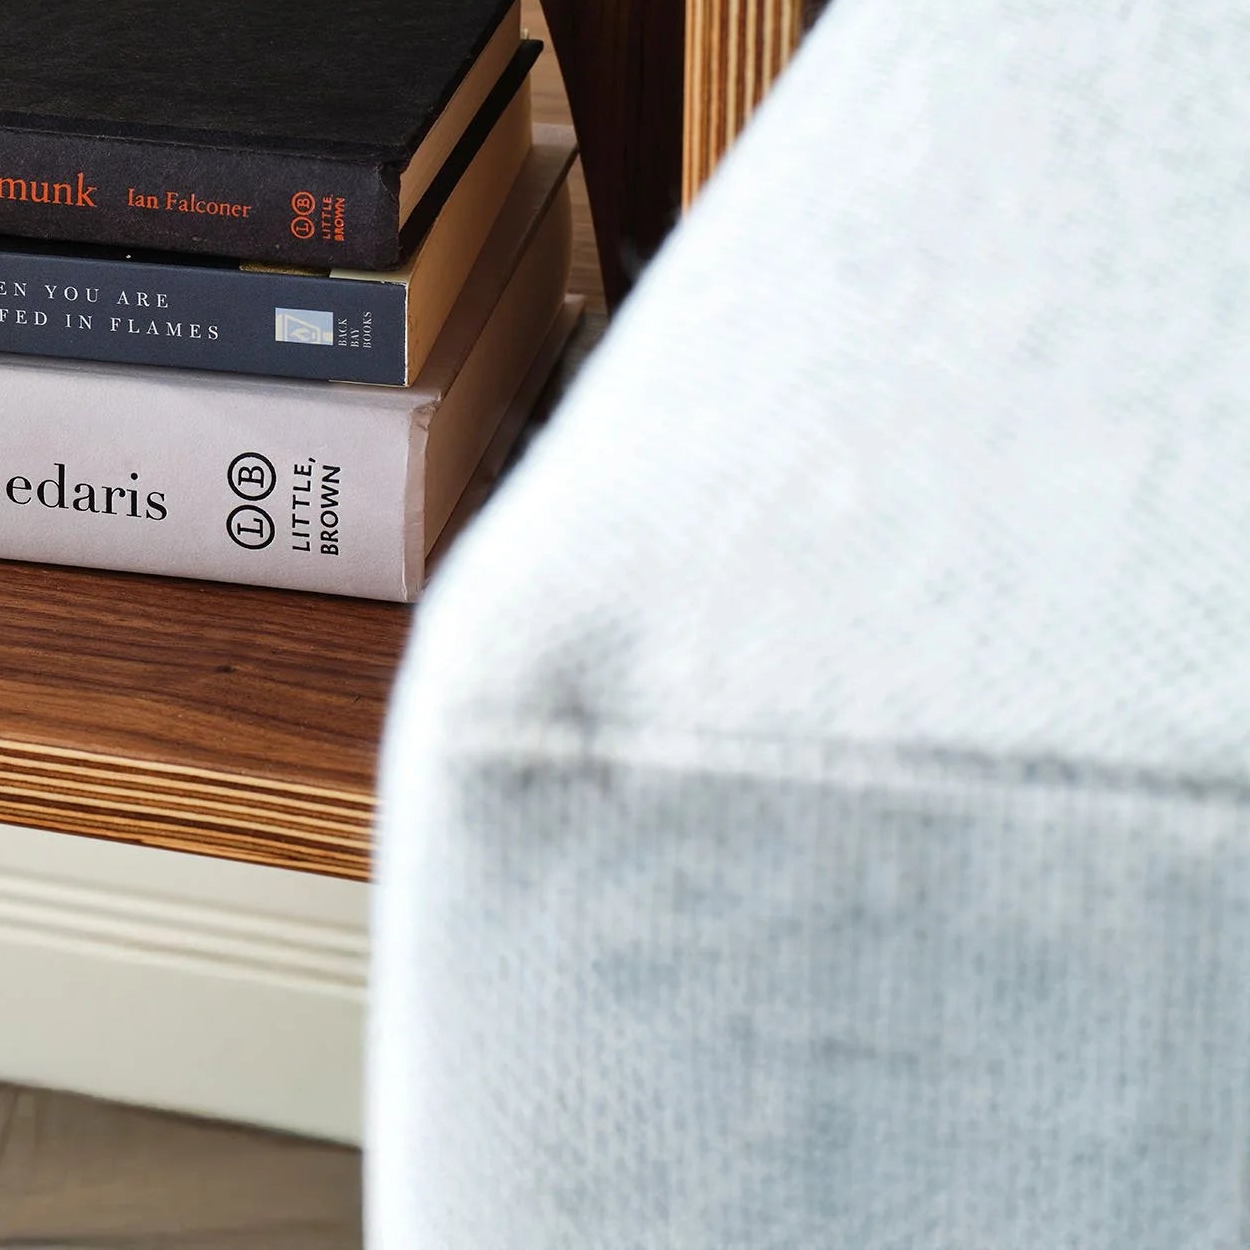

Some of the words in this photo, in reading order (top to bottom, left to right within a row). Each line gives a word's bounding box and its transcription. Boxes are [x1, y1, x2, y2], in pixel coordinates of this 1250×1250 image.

[126, 187, 159, 210] Ian
[165, 190, 251, 218] Falconer
[334, 197, 345, 241] BROWN
[44, 284, 100, 303] YOU
[116, 290, 169, 309] ARE
[65, 313, 93, 331] IN
[110, 317, 220, 341] FLAMES
[338, 318, 347, 347] BACK
[350, 329, 359, 347] BAY
[363, 311, 372, 348] BOOKS
[292, 457, 316, 551] LITTLE,
[320, 464, 341, 556] BROWN
